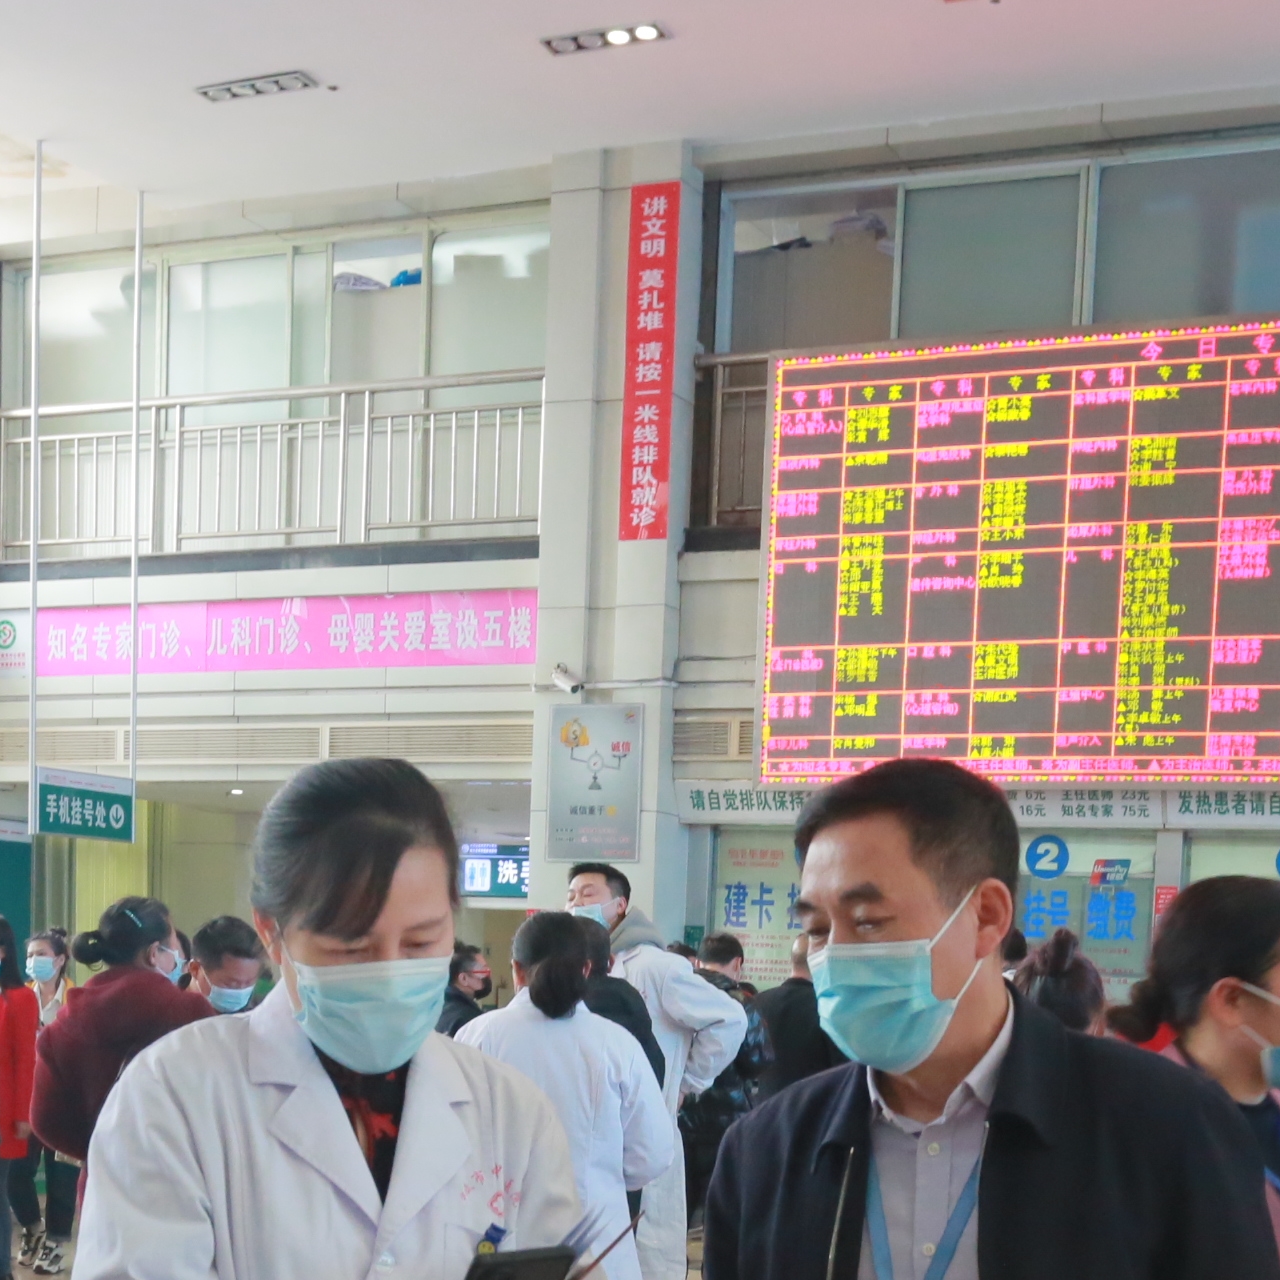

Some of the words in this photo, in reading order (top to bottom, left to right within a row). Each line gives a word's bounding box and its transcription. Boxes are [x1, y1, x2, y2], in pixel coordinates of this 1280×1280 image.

[640, 196, 668, 258] 讲文明
[637, 268, 665, 331] 莫扎堆
[630, 342, 663, 527] 请按一米线排队就诊
[1131, 627, 1179, 639] 主治医师
[907, 646, 952, 659] 口腔科
[973, 666, 1019, 681] 主治医师
[611, 740, 632, 752] 诚信
[46, 794, 107, 828] 手机挂号处
[690, 789, 812, 812] 请自觉排队保持
[1019, 805, 1047, 817] 16元
[1061, 804, 1114, 818] 知名专家
[1122, 804, 1150, 818] 75元
[1034, 842, 1059, 871] 2
[1093, 864, 1129, 875] UnionPay
[723, 881, 775, 930] 建卡
[1023, 889, 1070, 938] 挂号
[1087, 890, 1137, 941] 缴费
